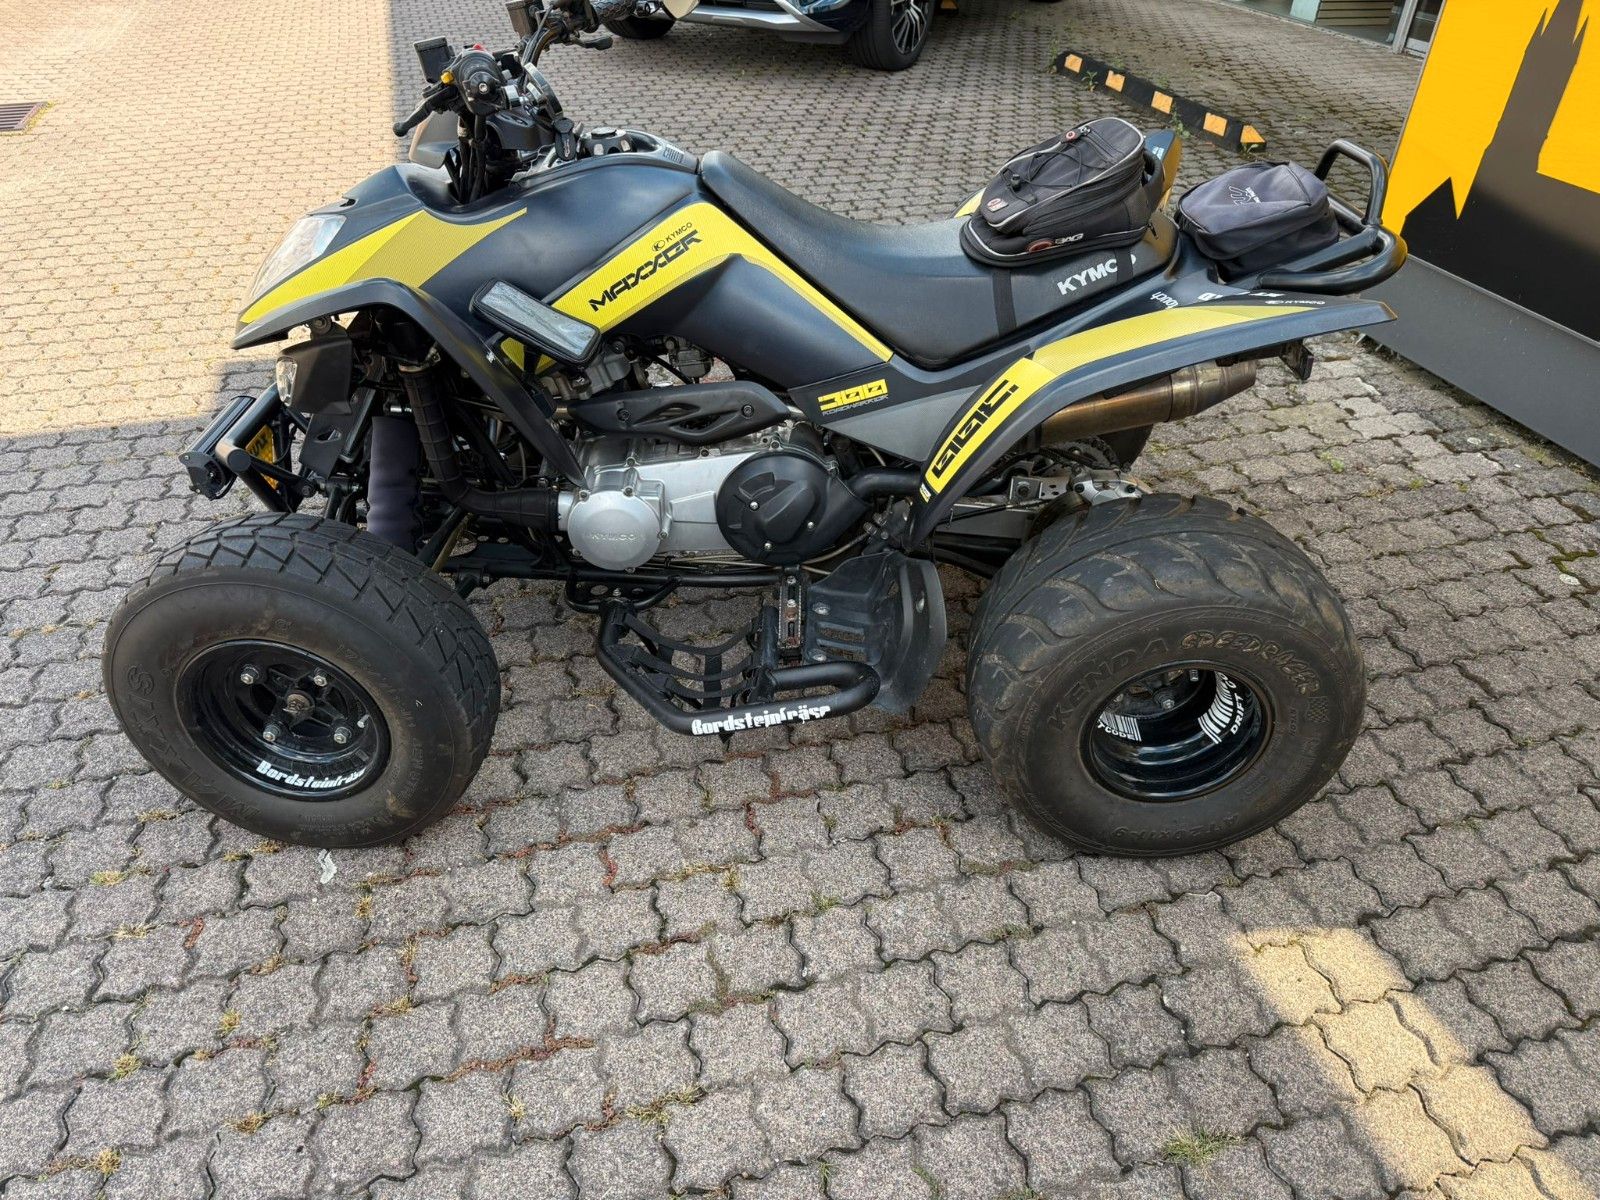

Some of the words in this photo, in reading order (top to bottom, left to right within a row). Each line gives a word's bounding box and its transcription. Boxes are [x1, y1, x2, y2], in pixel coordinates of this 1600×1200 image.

[666, 222, 692, 242] KYMCO
[588, 229, 703, 312] MAXXER
[818, 379, 888, 411] 300
[931, 379, 1020, 479] 300
[1046, 637, 1169, 728] KENDA
[1105, 726, 1136, 741] CODE
[1230, 693, 1244, 735] DRIFT
